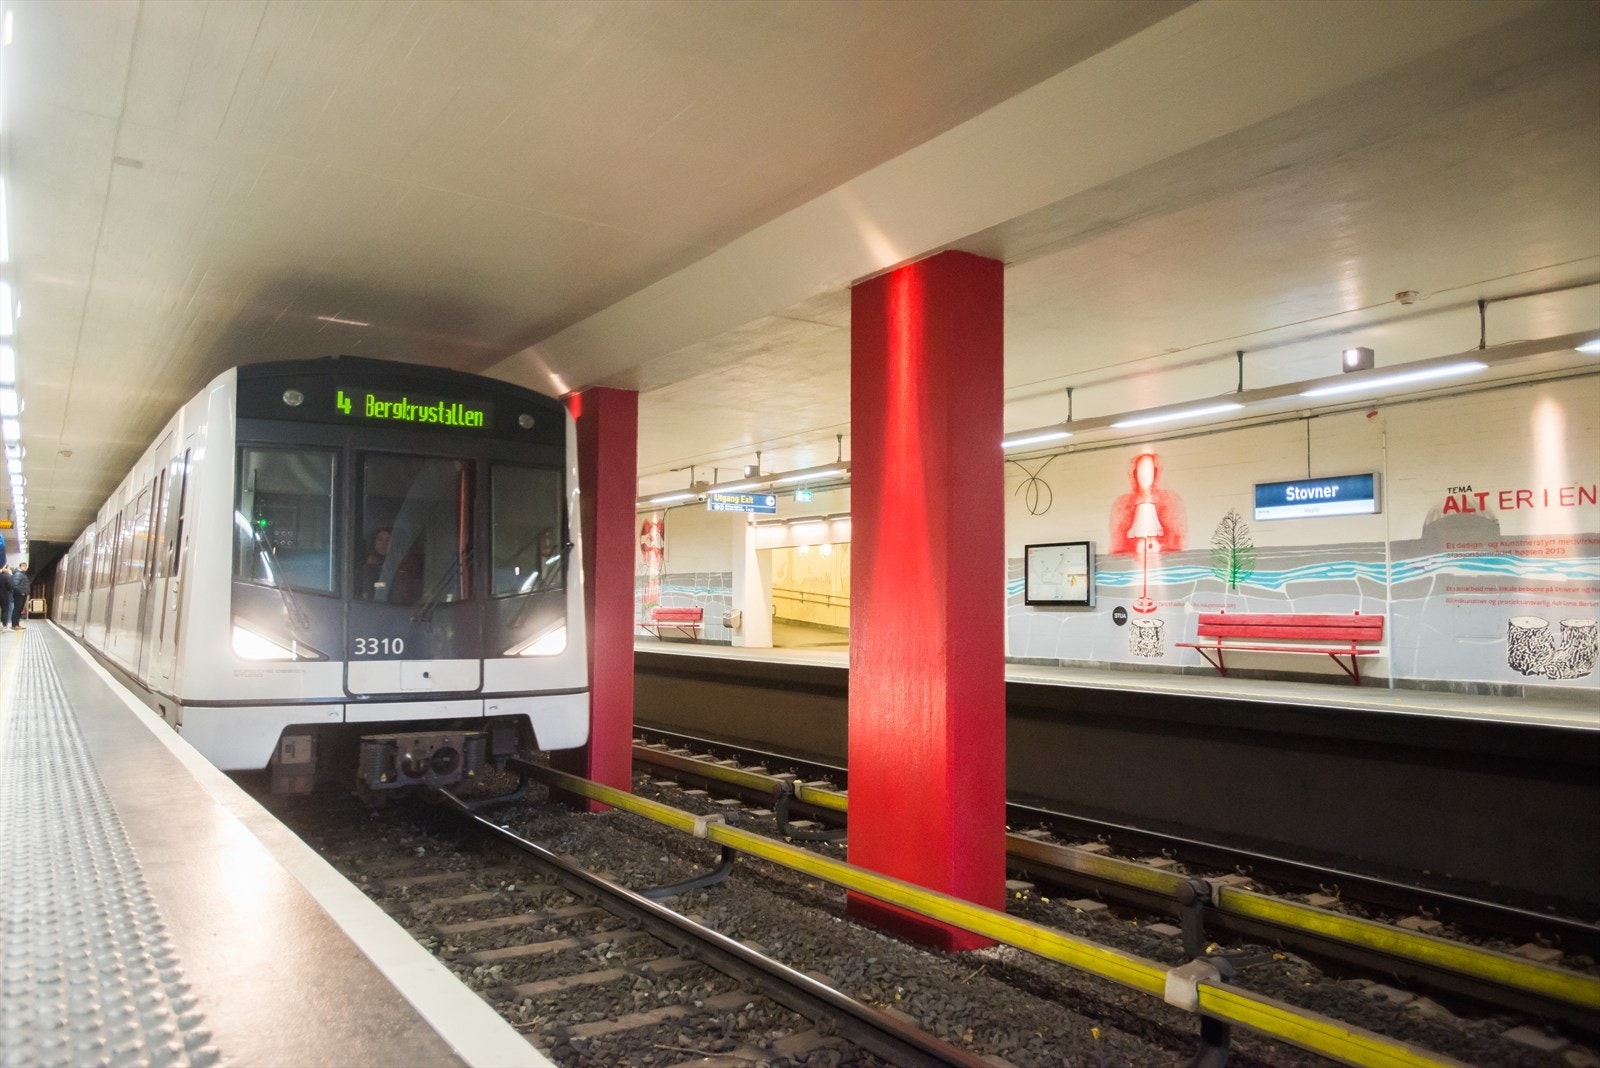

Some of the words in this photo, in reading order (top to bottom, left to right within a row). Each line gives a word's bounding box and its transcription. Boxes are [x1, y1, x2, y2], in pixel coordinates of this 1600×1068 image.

[336, 390, 352, 415] 4
[365, 393, 484, 427] Bergkrystallen
[1286, 485, 1340, 501] Stovner
[1447, 485, 1473, 494] TEMA
[714, 494, 739, 504] Utgang
[740, 495, 754, 504] Exit
[1443, 492, 1489, 514] ALT
[1499, 489, 1534, 510] ER
[1544, 489, 1548, 507] I
[1560, 485, 1597, 506] EN
[1488, 541, 1498, 549] og
[1545, 547, 1566, 555] 2013
[353, 637, 405, 655] 3310
